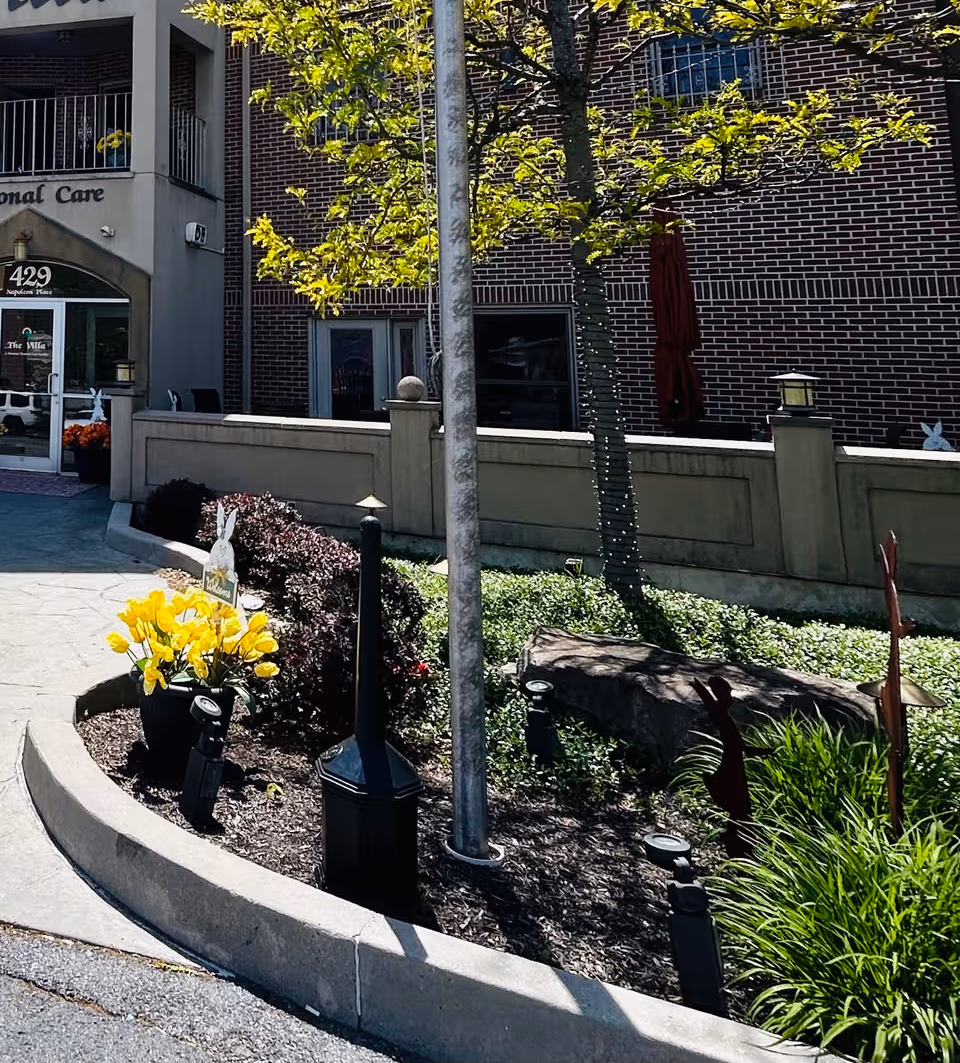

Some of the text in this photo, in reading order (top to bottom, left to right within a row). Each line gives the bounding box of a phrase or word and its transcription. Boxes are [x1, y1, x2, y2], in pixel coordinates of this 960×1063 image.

[55, 185, 105, 204] Care
[9, 266, 52, 288] 429
[7, 341, 46, 350] The Villa
